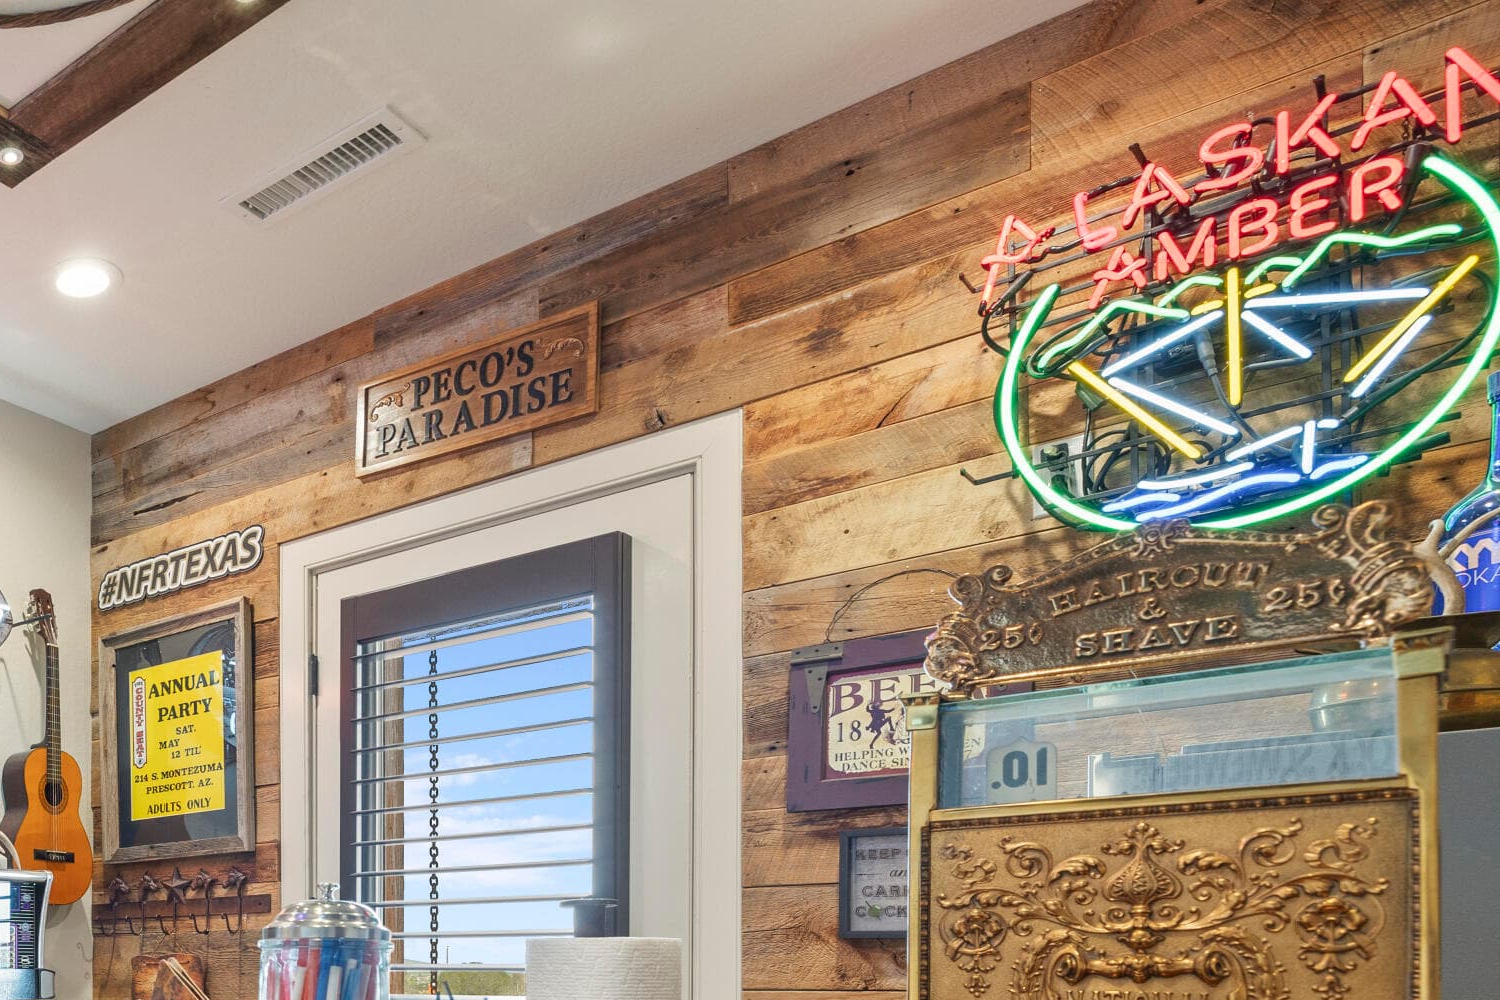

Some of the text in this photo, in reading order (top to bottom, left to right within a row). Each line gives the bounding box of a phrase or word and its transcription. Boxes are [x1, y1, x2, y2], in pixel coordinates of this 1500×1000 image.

[980, 46, 1500, 316] ALASKAN
[1088, 156, 1405, 310] AMBER
[410, 340, 535, 412] PECO'S
[375, 368, 574, 459] PARADISE
[100, 529, 262, 608] #NFRTEXAS
[1049, 561, 1271, 619] HAIRCUT
[1075, 614, 1240, 659] SHAVE
[148, 670, 220, 699] ANNUAL
[829, 673, 950, 718] BEE
[157, 698, 212, 723] PARTY
[159, 738, 180, 750] MAY
[175, 724, 197, 735] SAT.
[171, 750, 181, 759] 12
[834, 747, 895, 762] HELPING
[841, 758, 887, 772] DANCE
[160, 762, 224, 780] MONTEZUMA
[147, 797, 212, 815] ADULTS ONLY
